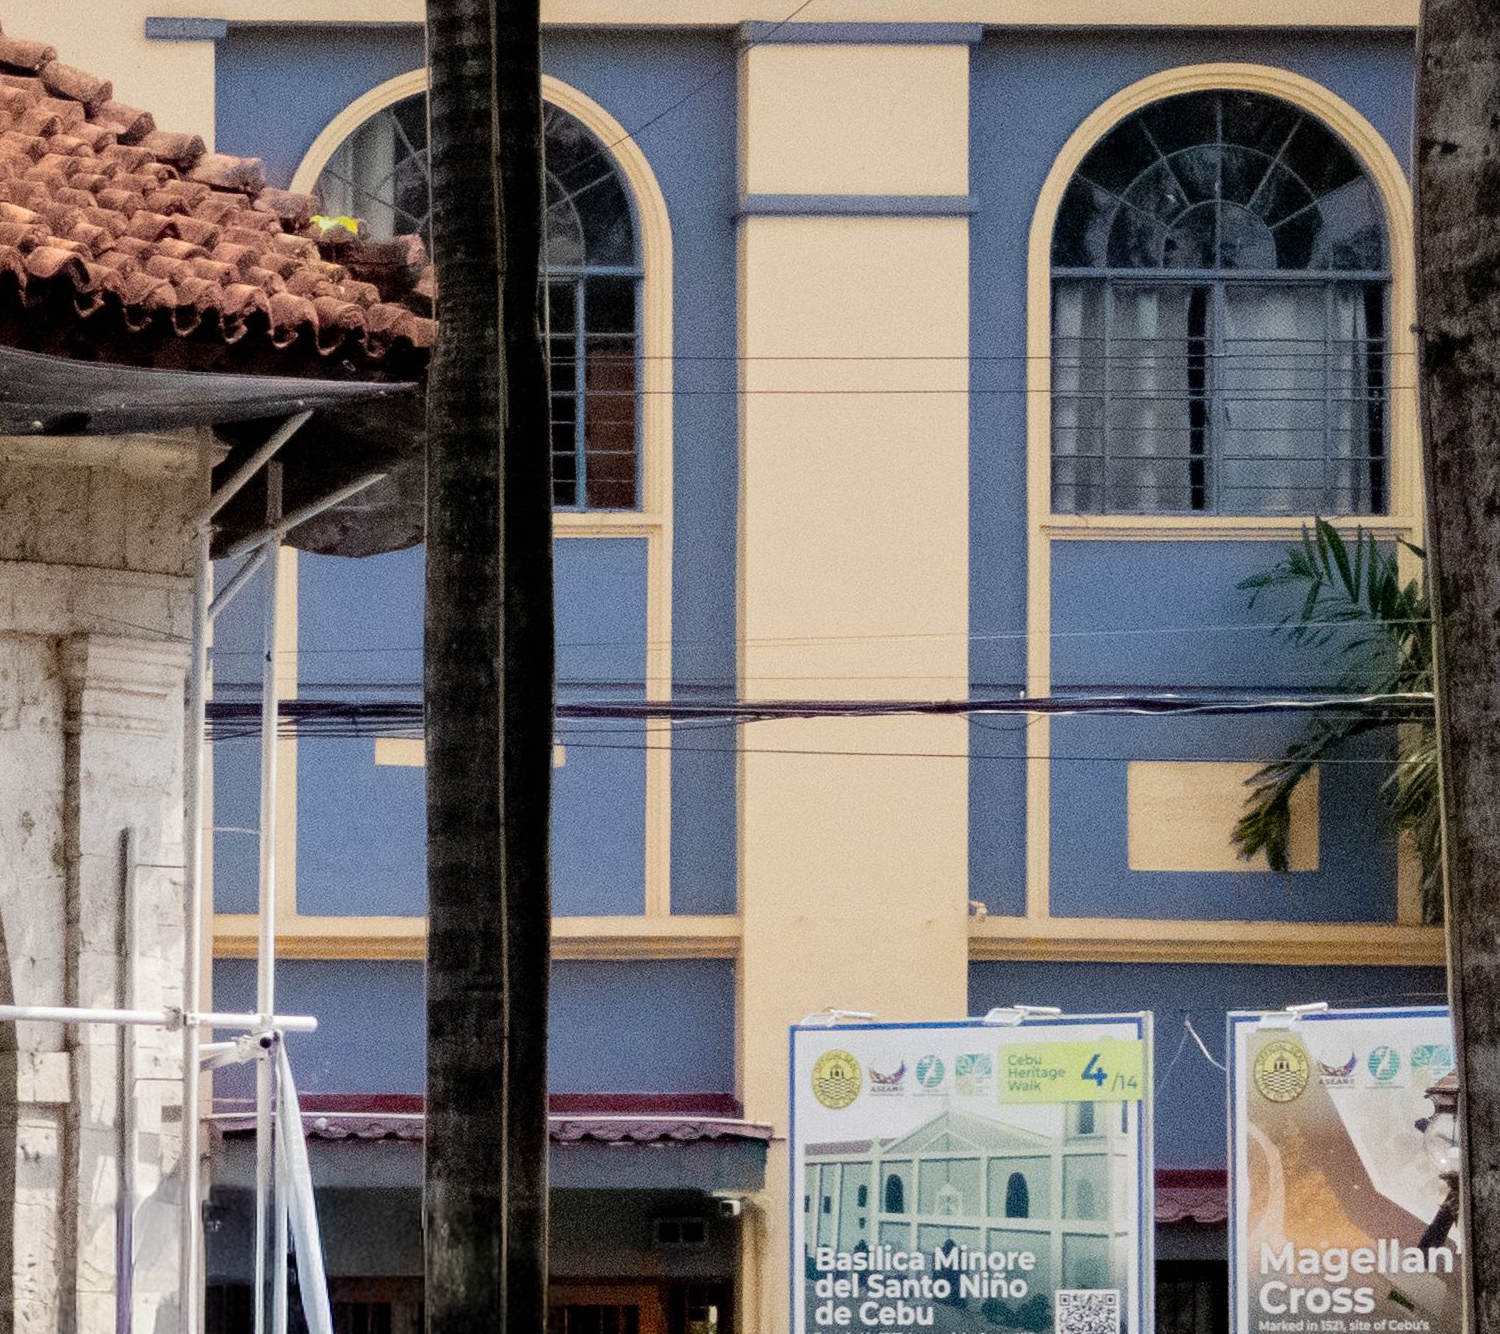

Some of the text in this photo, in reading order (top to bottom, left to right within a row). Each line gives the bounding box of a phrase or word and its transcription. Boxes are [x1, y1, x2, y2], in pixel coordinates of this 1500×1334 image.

[1007, 1054, 1042, 1066] Cebu
[1007, 1066, 1066, 1080] Heritage
[1007, 1080, 1042, 1092] Walk
[815, 1244, 1037, 1271] Basilica Minore
[1259, 1238, 1454, 1283] Magellan
[814, 1271, 1029, 1299] del Santo Niño
[1258, 1280, 1376, 1315] Cross
[814, 1300, 935, 1326] de Cebu
[1258, 1320, 1304, 1332] Marked
[1306, 1320, 1319, 1331] in
[1349, 1320, 1371, 1331] site
[1373, 1320, 1387, 1331] of
